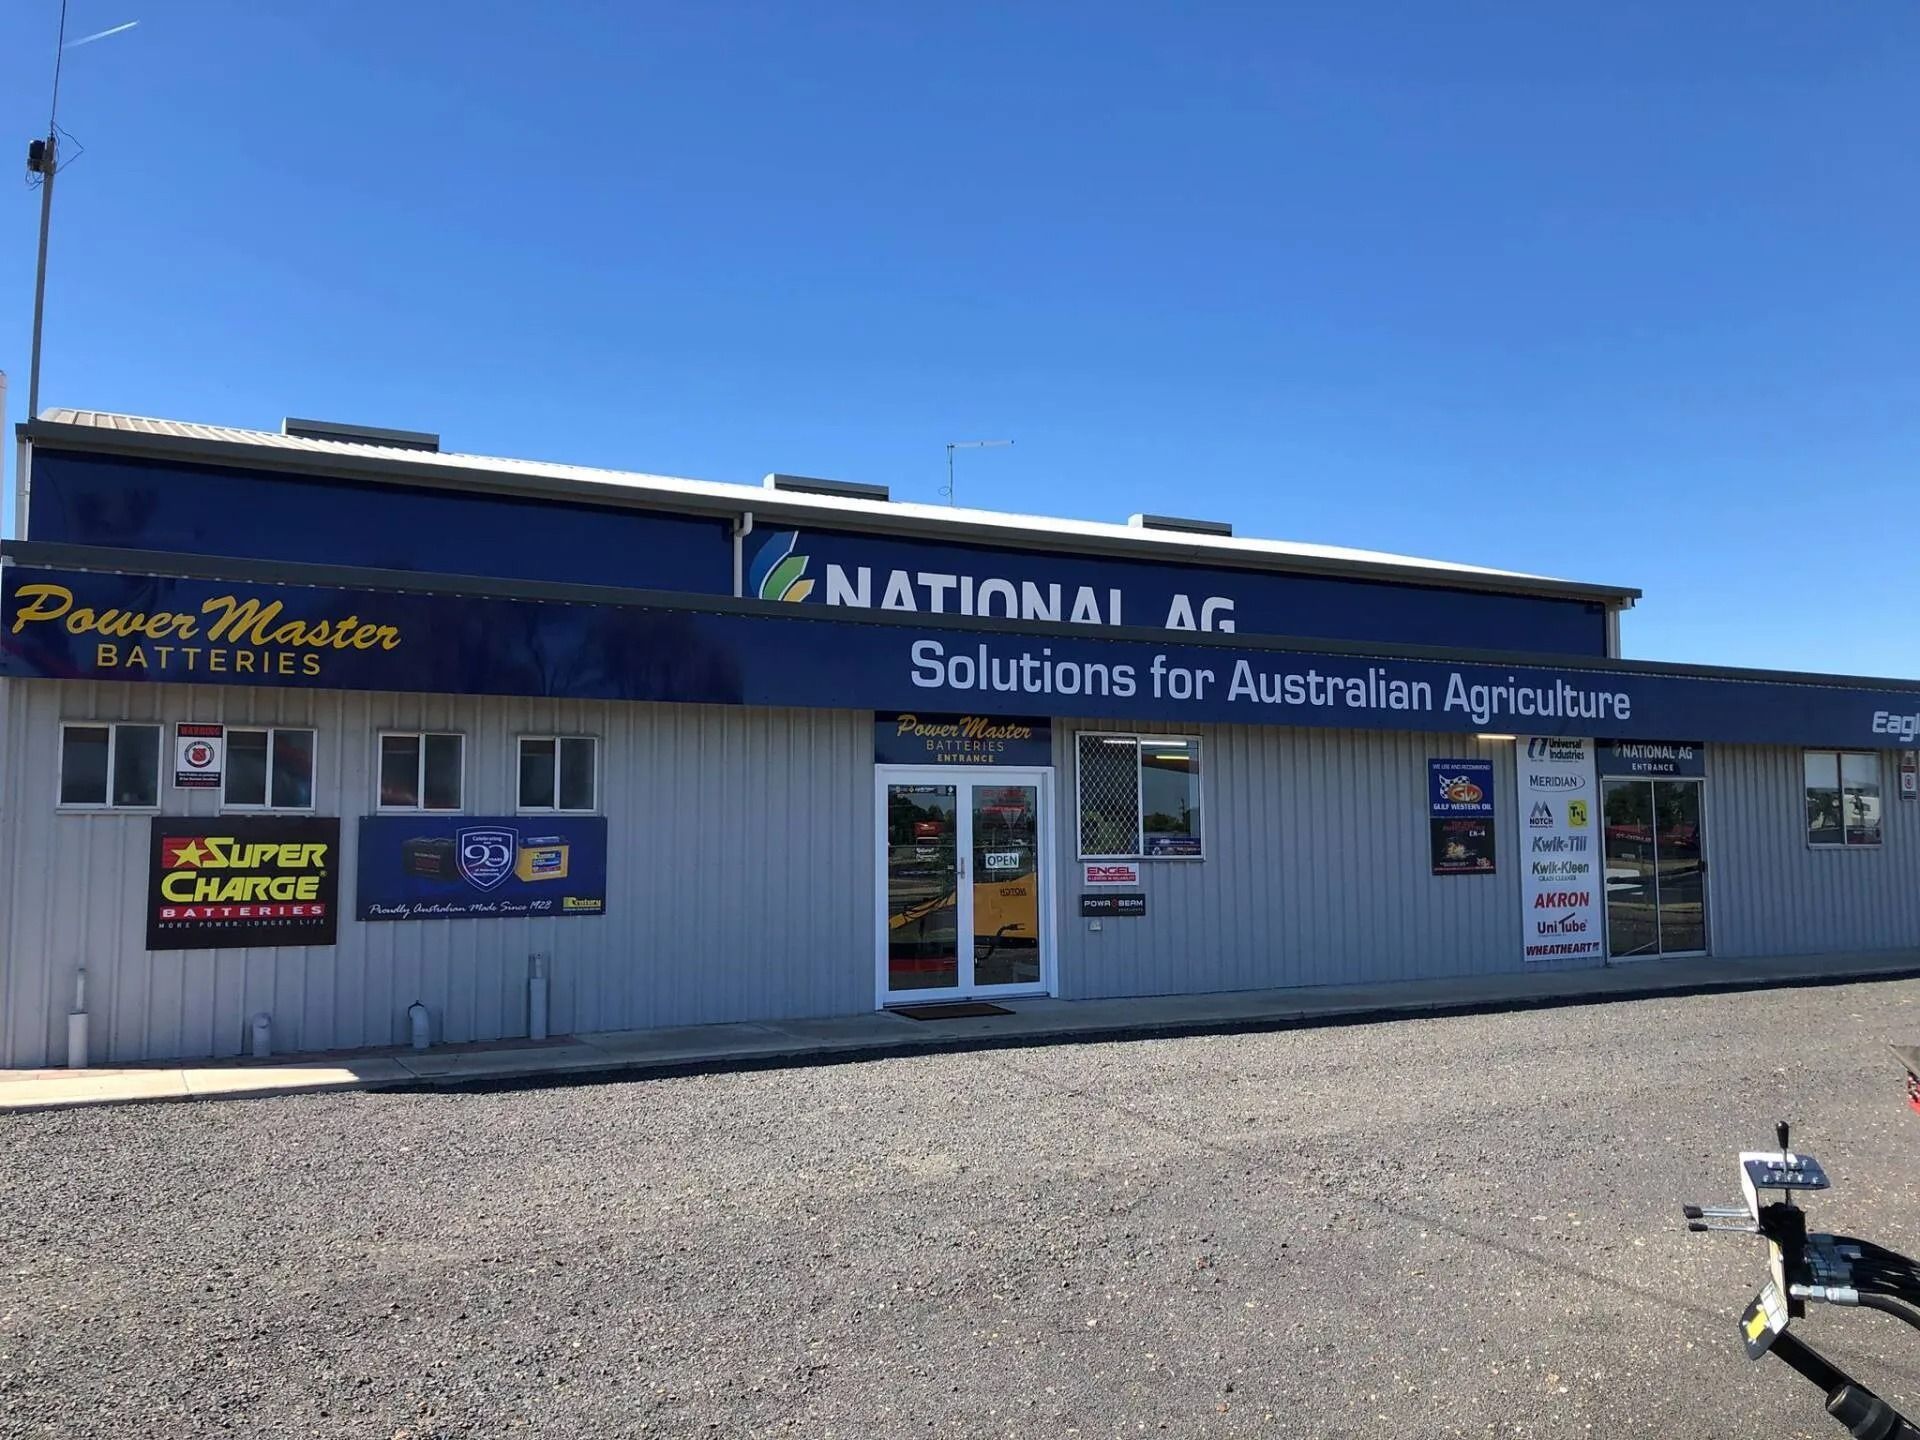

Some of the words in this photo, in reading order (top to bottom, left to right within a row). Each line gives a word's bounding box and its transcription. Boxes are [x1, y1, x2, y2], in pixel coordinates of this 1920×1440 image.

[11, 584, 201, 640] Power
[201, 595, 402, 651] Master
[97, 643, 321, 676] BATTERIES
[911, 639, 1137, 696] Solutions
[1150, 654, 1215, 700] for
[1227, 659, 1432, 711] Australian
[1443, 672, 1631, 725] Agriculture
[897, 714, 960, 738] Power
[959, 716, 1032, 739] Master
[1872, 710, 1920, 742] Eagl
[926, 739, 1004, 752] BATTERIES
[1622, 743, 1676, 759] NATIONAL
[1678, 747, 1693, 760] AG
[937, 754, 995, 763] ENTRANCE
[1549, 749, 1585, 760] Industries
[1632, 763, 1674, 771] ENTRANCE
[1529, 775, 1577, 787] MERIDIAN
[1450, 803, 1480, 811] WESTERN
[200, 837, 328, 868] SUPER
[464, 844, 509, 867] 90
[987, 855, 1017, 867] OPEN
[1532, 860, 1589, 875] Kwik-Kleen
[1087, 866, 1136, 875] ENGEL
[1118, 900, 1143, 908] BEAM
[1534, 892, 1590, 909] AKRON
[162, 906, 322, 918] BATTERIES
[369, 903, 411, 918] Proudly
[413, 903, 466, 914] Australian
[499, 901, 527, 911] Since
[1526, 943, 1592, 956] WHEATHEART
